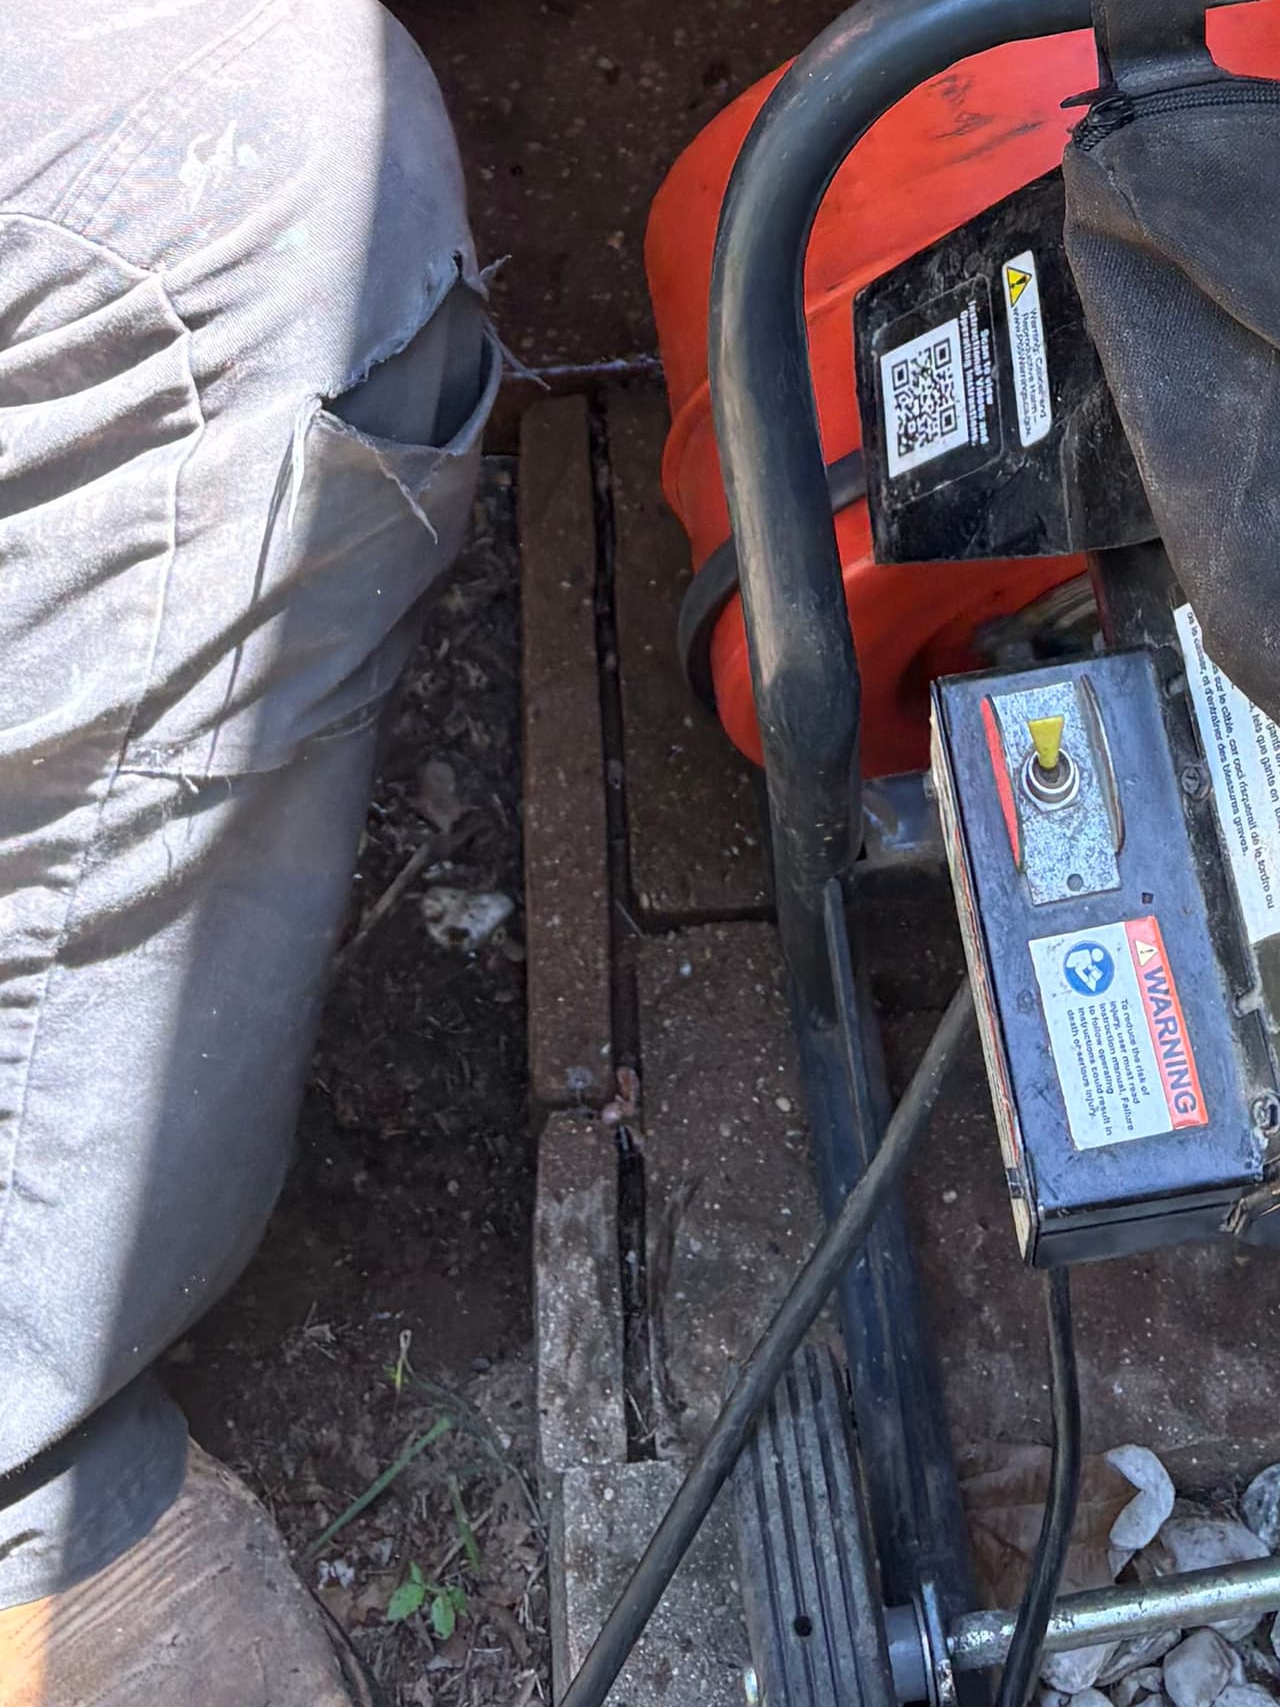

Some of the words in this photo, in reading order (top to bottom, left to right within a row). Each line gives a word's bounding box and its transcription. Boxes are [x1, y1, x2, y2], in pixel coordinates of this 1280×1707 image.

[983, 360, 991, 375] to
[1087, 1004, 1096, 1015] to
[1119, 998, 1129, 1010] To
[1065, 1009, 1079, 1036] death
[1074, 1007, 1097, 1064] instructions
[1089, 1017, 1104, 1045] follow
[1122, 1012, 1138, 1045] reduce
[1072, 1038, 1080, 1048] or
[1107, 1000, 1122, 1030] injury,
[1115, 1032, 1126, 1053] user
[1121, 1055, 1133, 1080] must
[1127, 1081, 1140, 1104] read
[1144, 965, 1197, 1115] WARNING
[1075, 1050, 1091, 1087] serious
[1096, 1002, 1117, 1054] instruction
[1109, 1056, 1127, 1094] manual.
[1119, 1097, 1136, 1130] Failure
[1131, 1047, 1142, 1063] the
[1089, 1066, 1104, 1094] could
[1095, 1048, 1115, 1095] operating
[1135, 1064, 1147, 1083] risk
[1082, 1089, 1098, 1119] injury.
[1140, 1084, 1150, 1096] of
[1096, 1095, 1111, 1123] result
[1104, 1126, 1113, 1136] in
